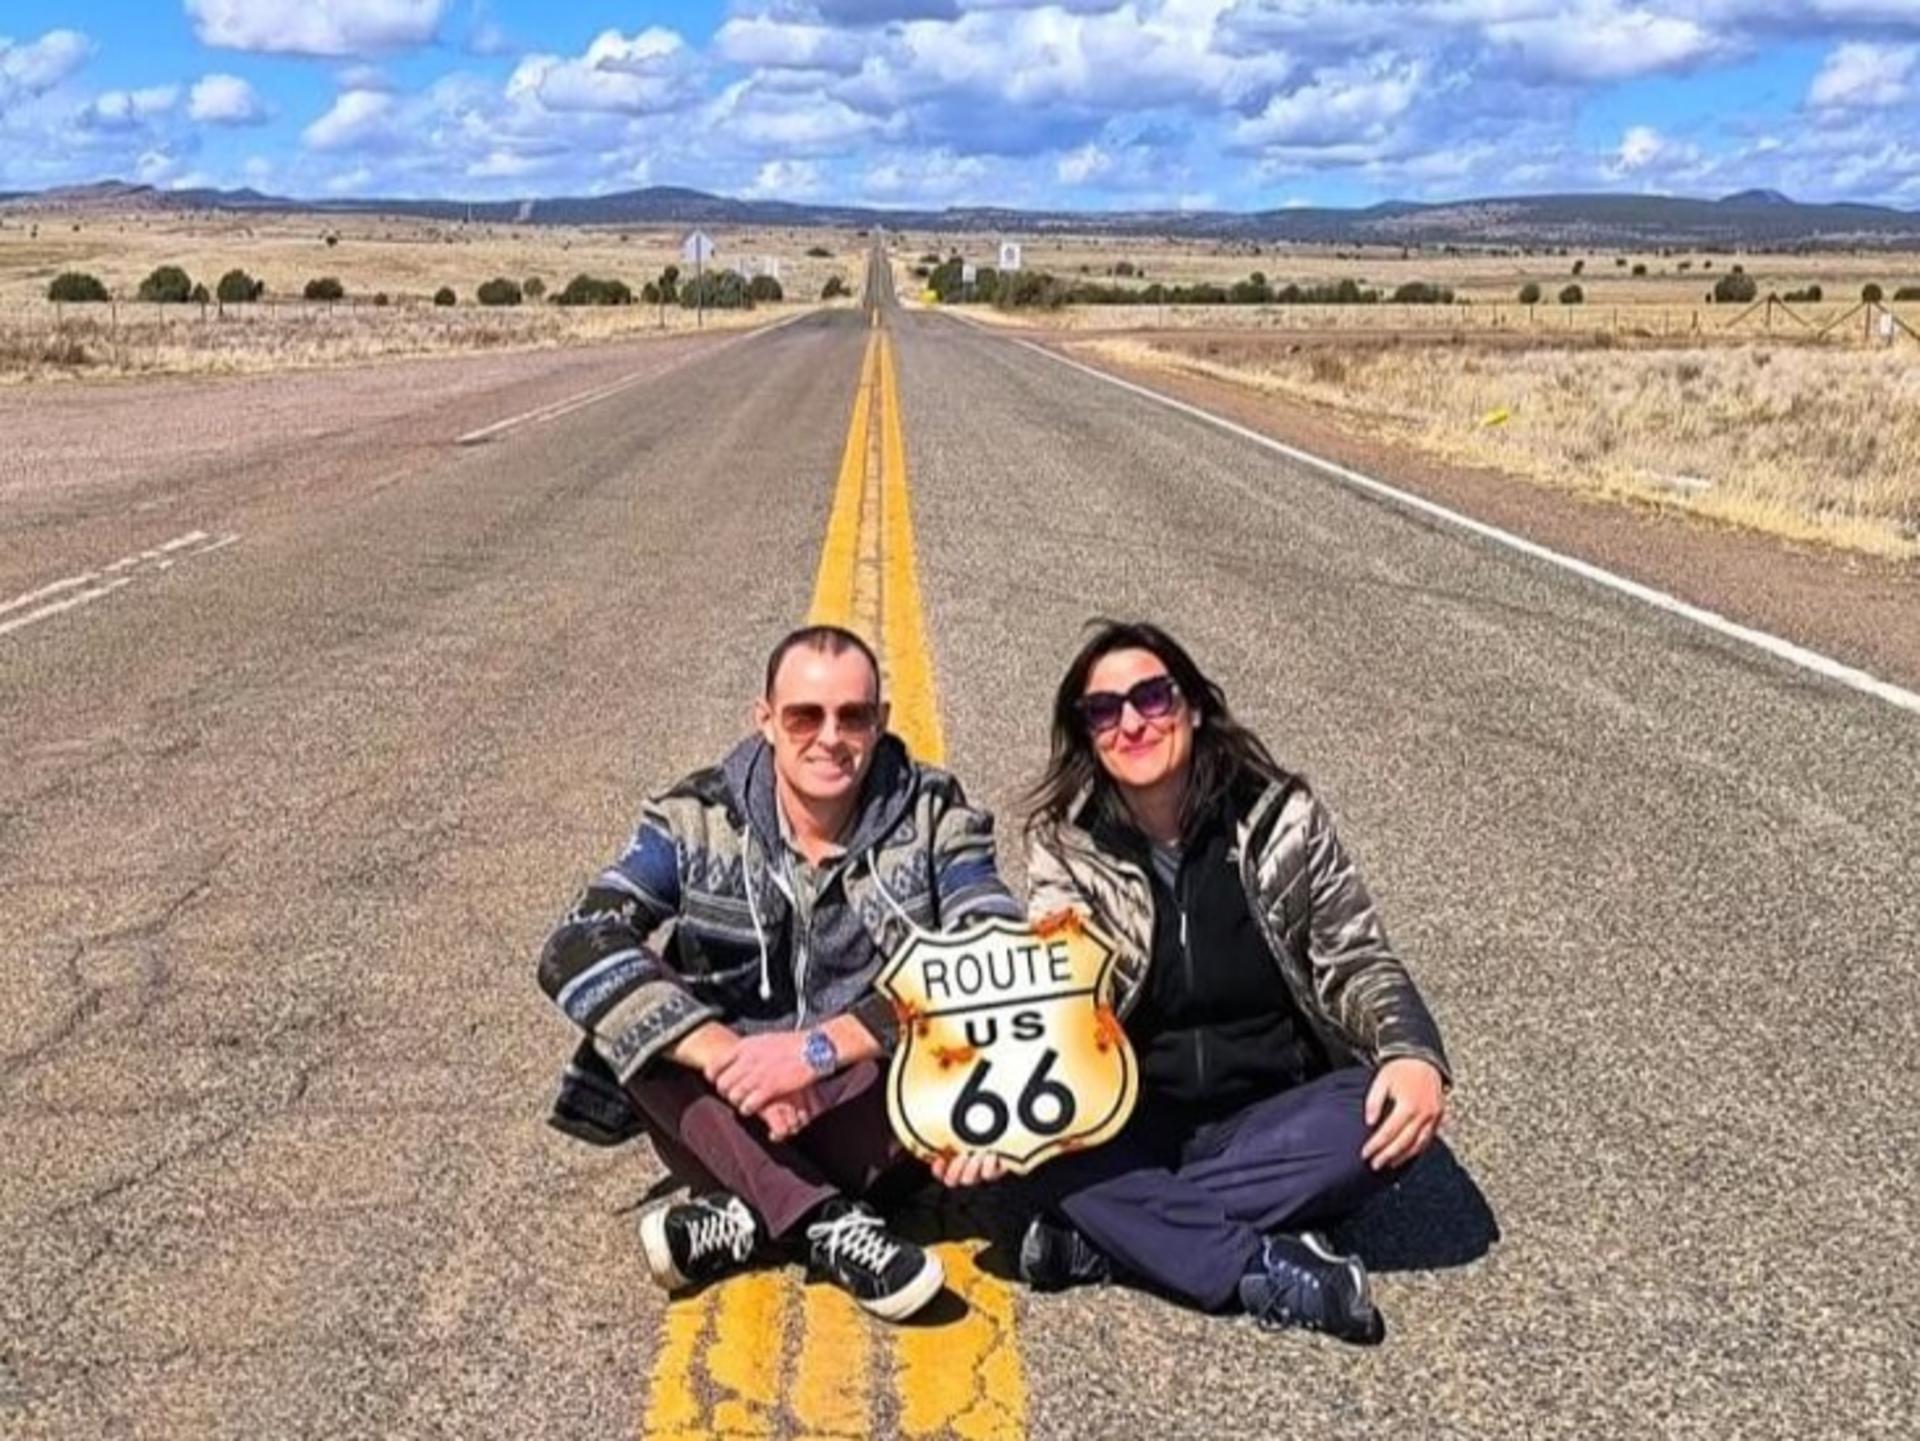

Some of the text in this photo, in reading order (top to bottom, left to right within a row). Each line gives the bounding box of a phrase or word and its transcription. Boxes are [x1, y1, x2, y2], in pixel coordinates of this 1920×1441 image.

[922, 941, 1072, 999] ROUTE
[965, 1010, 1045, 1048] US
[951, 1047, 1076, 1146] 66
